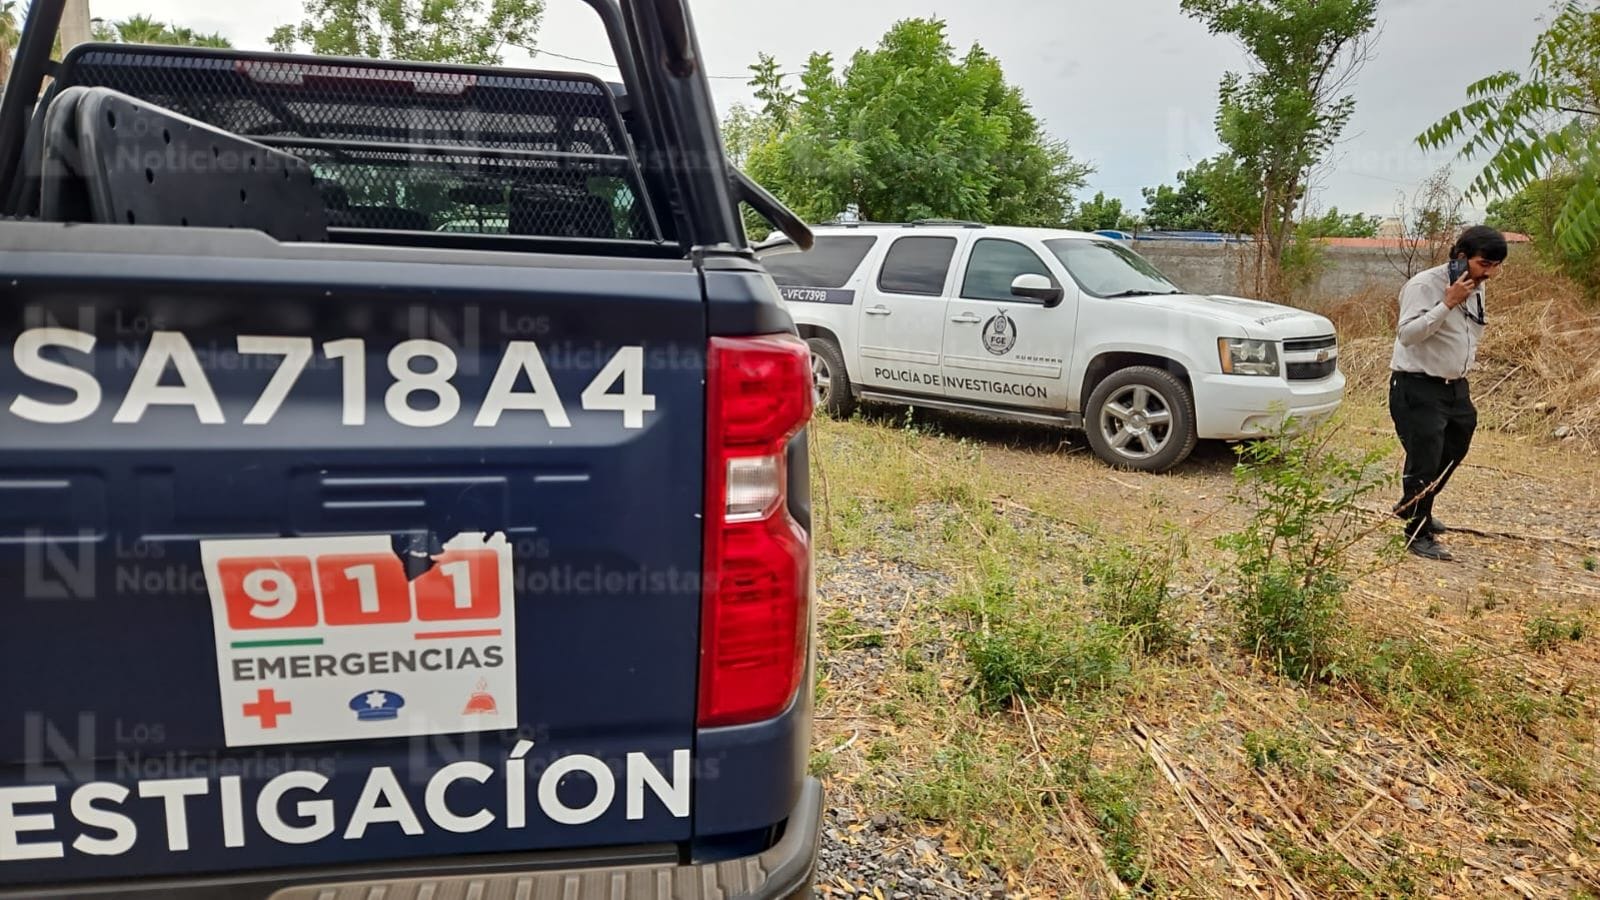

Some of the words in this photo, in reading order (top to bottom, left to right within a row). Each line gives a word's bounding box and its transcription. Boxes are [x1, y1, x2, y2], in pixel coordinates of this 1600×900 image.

[991, 336, 1006, 345] FGE
[9, 327, 656, 428] SA718A4
[875, 367, 921, 384] POLICÍA
[923, 373, 941, 386] DE
[943, 376, 1047, 399] INVESTIGACIÓN
[242, 560, 473, 620] 911
[232, 645, 504, 682] EMERGENCIAS
